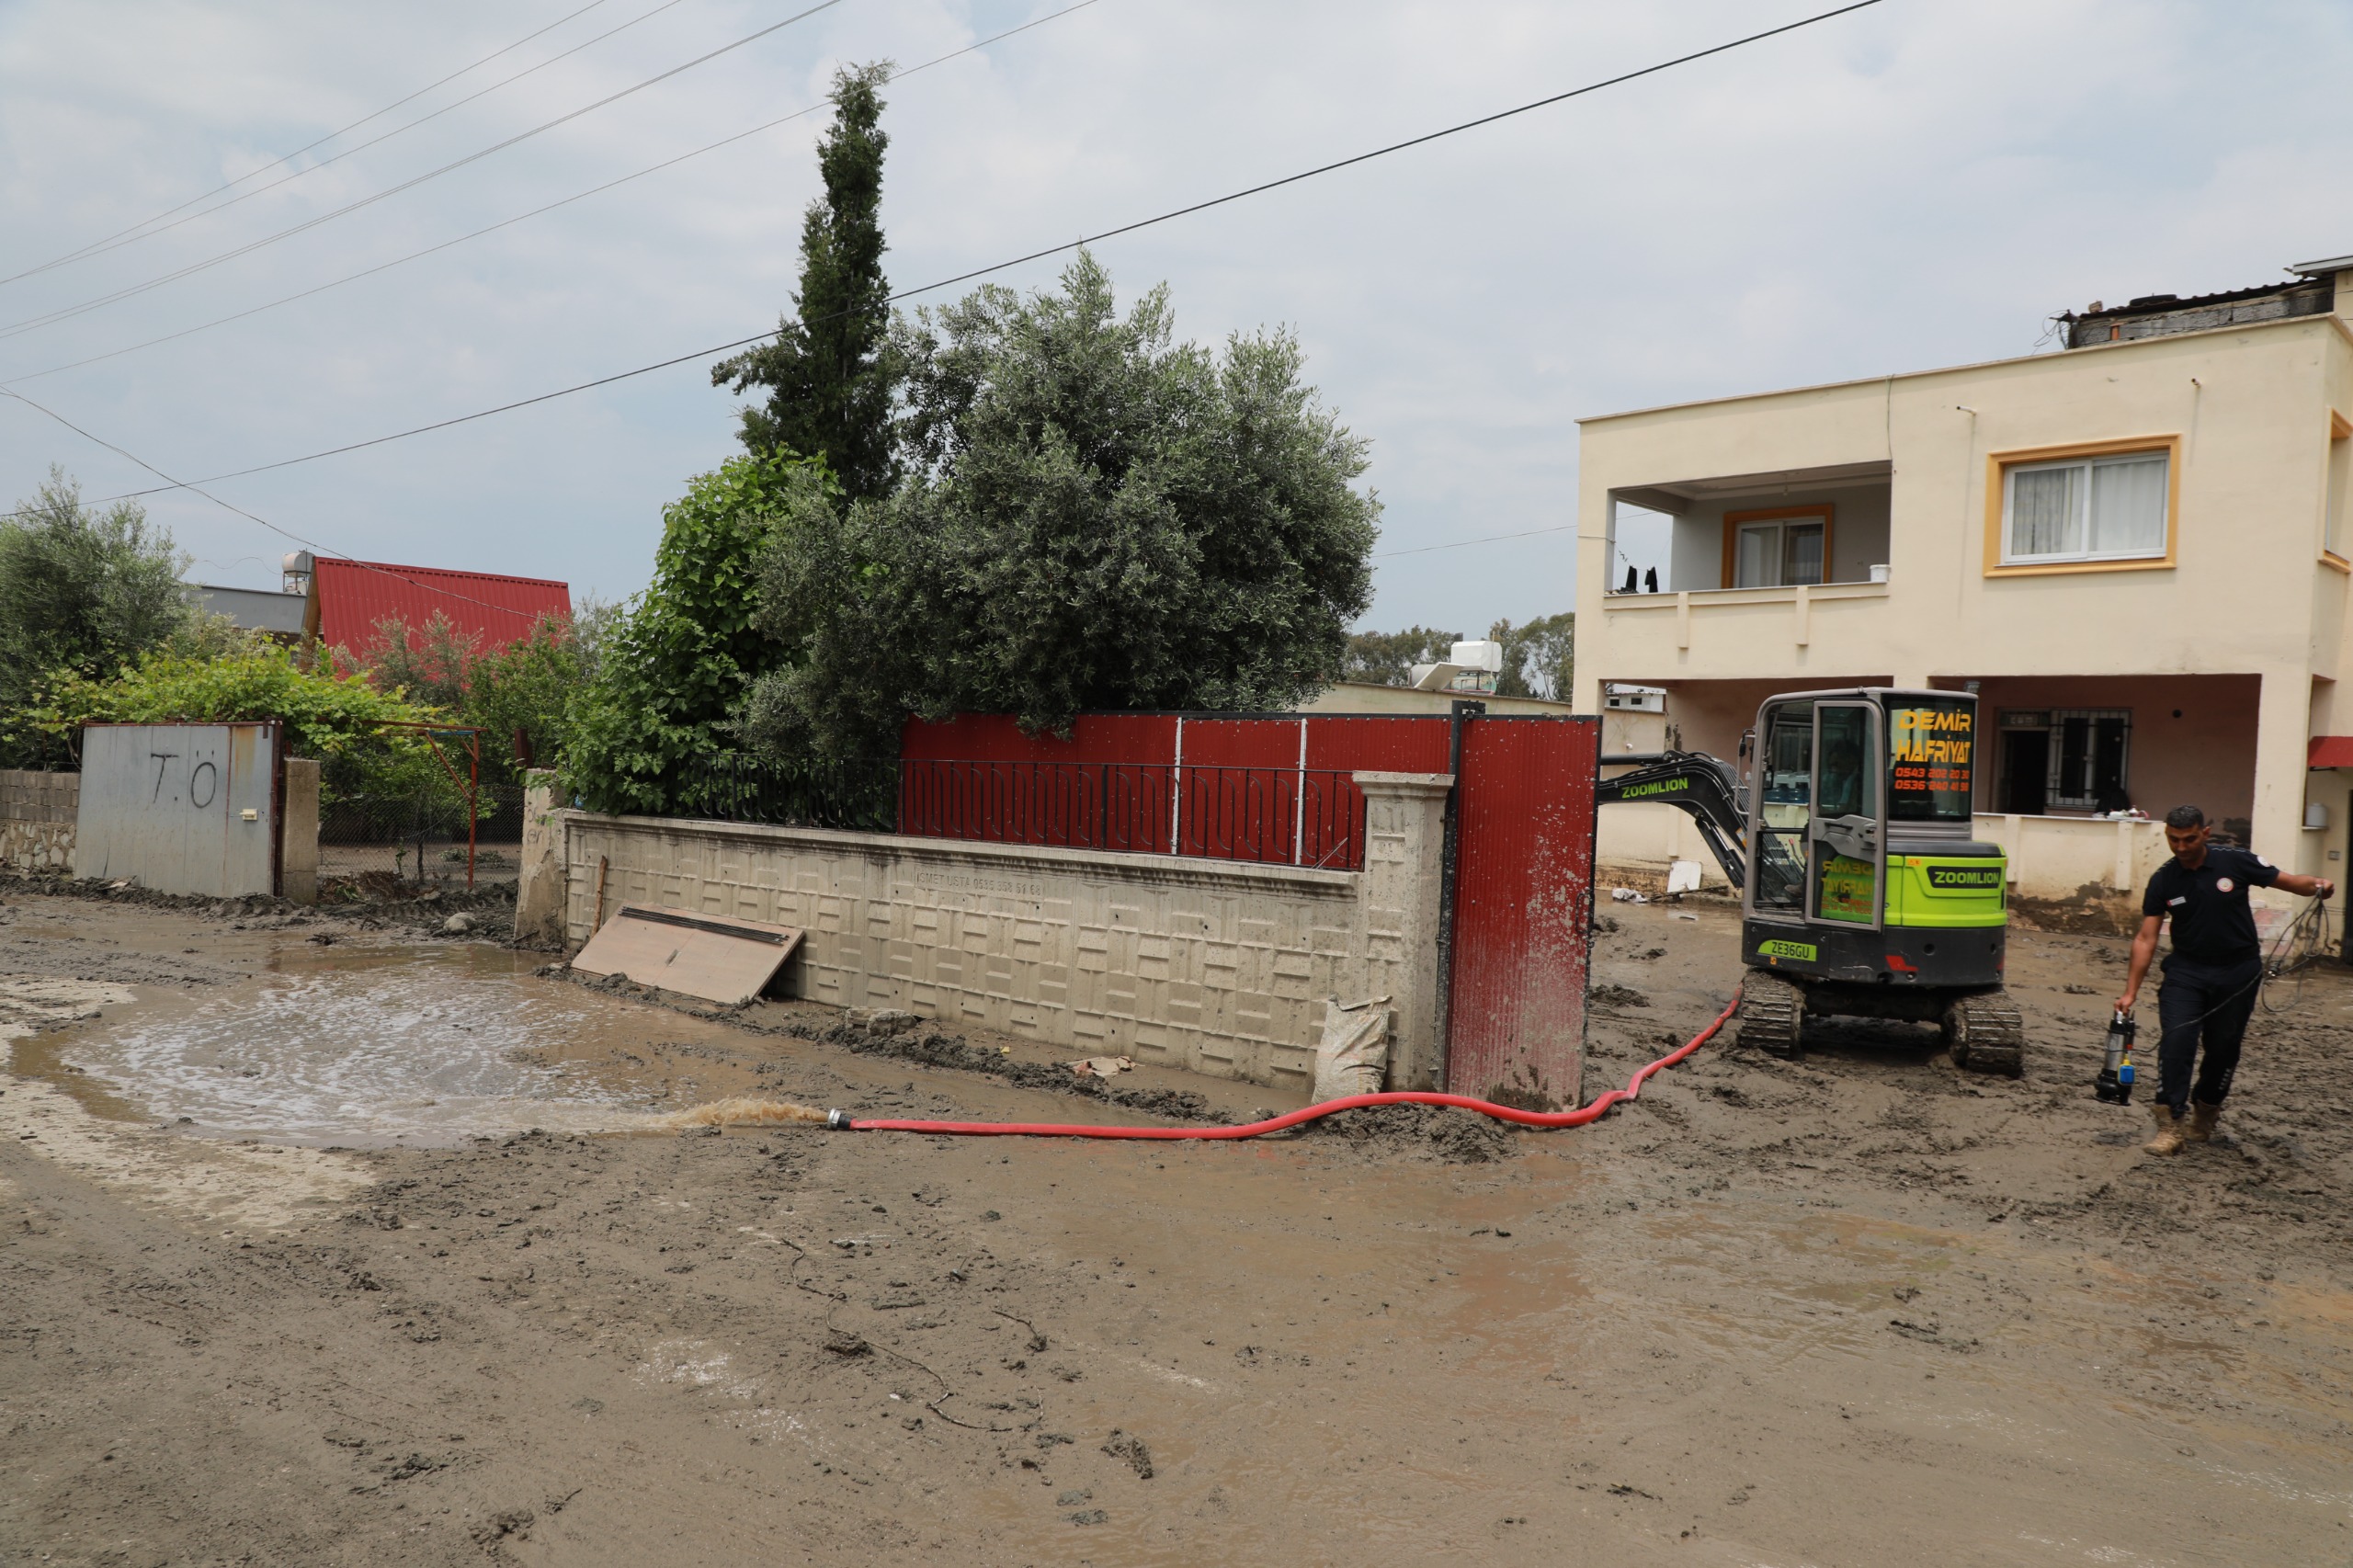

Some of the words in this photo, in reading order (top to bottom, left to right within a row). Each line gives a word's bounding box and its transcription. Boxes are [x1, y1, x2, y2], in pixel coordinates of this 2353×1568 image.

[1898, 709, 1972, 732] DEMİR
[1896, 734, 1971, 764] HAFRİYAT
[1895, 767, 1926, 778] 0543
[1927, 768, 1948, 779] 202
[1621, 778, 1688, 799] ZOOMLION
[1894, 779, 1927, 790] 0536
[1928, 780, 1949, 791] 240
[1934, 871, 2000, 884] ZOOMLION
[1772, 941, 1810, 959] ZE36GU
